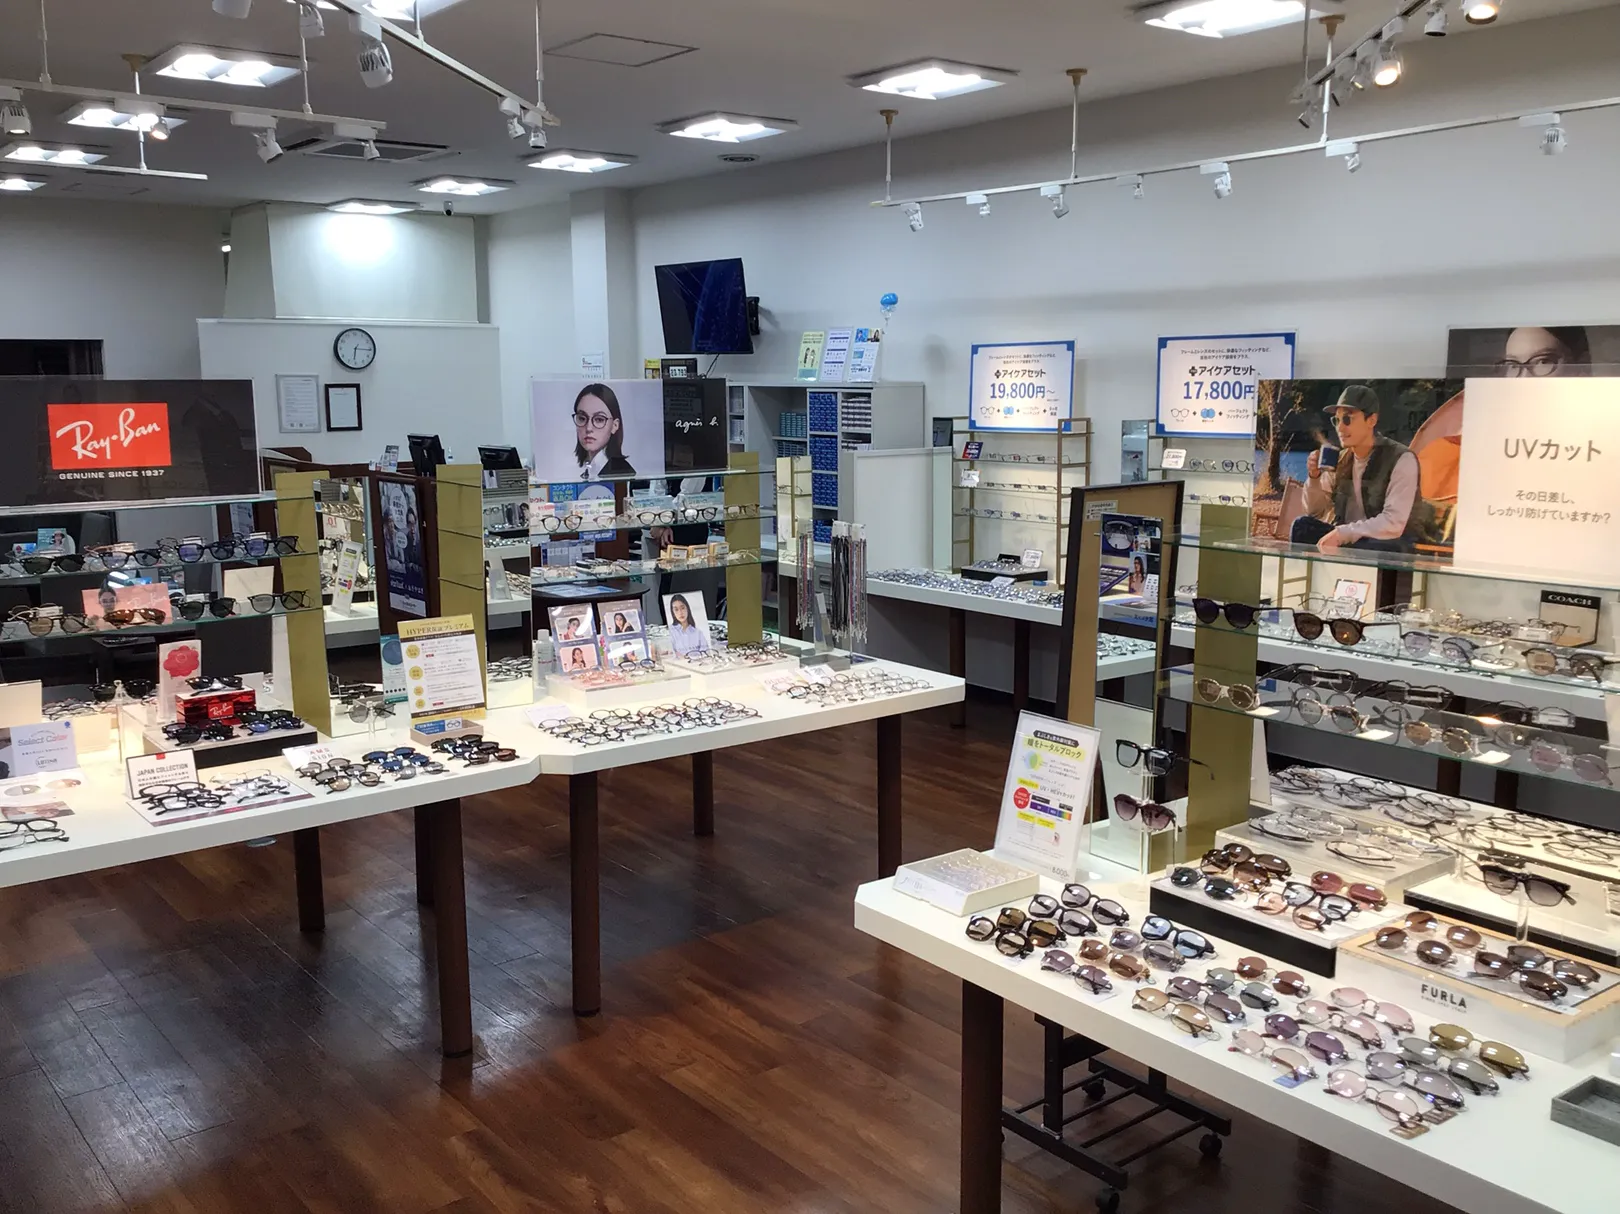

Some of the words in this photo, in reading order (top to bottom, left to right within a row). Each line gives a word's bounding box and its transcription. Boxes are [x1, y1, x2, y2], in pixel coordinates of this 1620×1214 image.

[1001, 369, 1046, 379] アイケアセット
[1199, 365, 1256, 376] アイケアセット
[1503, 438, 1602, 463] UVカット
[59, 471, 105, 480] GENUINE
[108, 470, 139, 479] SINCE
[142, 469, 165, 478] 1937
[1547, 594, 1592, 606] COACH
[137, 767, 155, 777] JAPAN
[156, 763, 189, 774] COLLECTION
[1421, 983, 1468, 1009] FURLA
